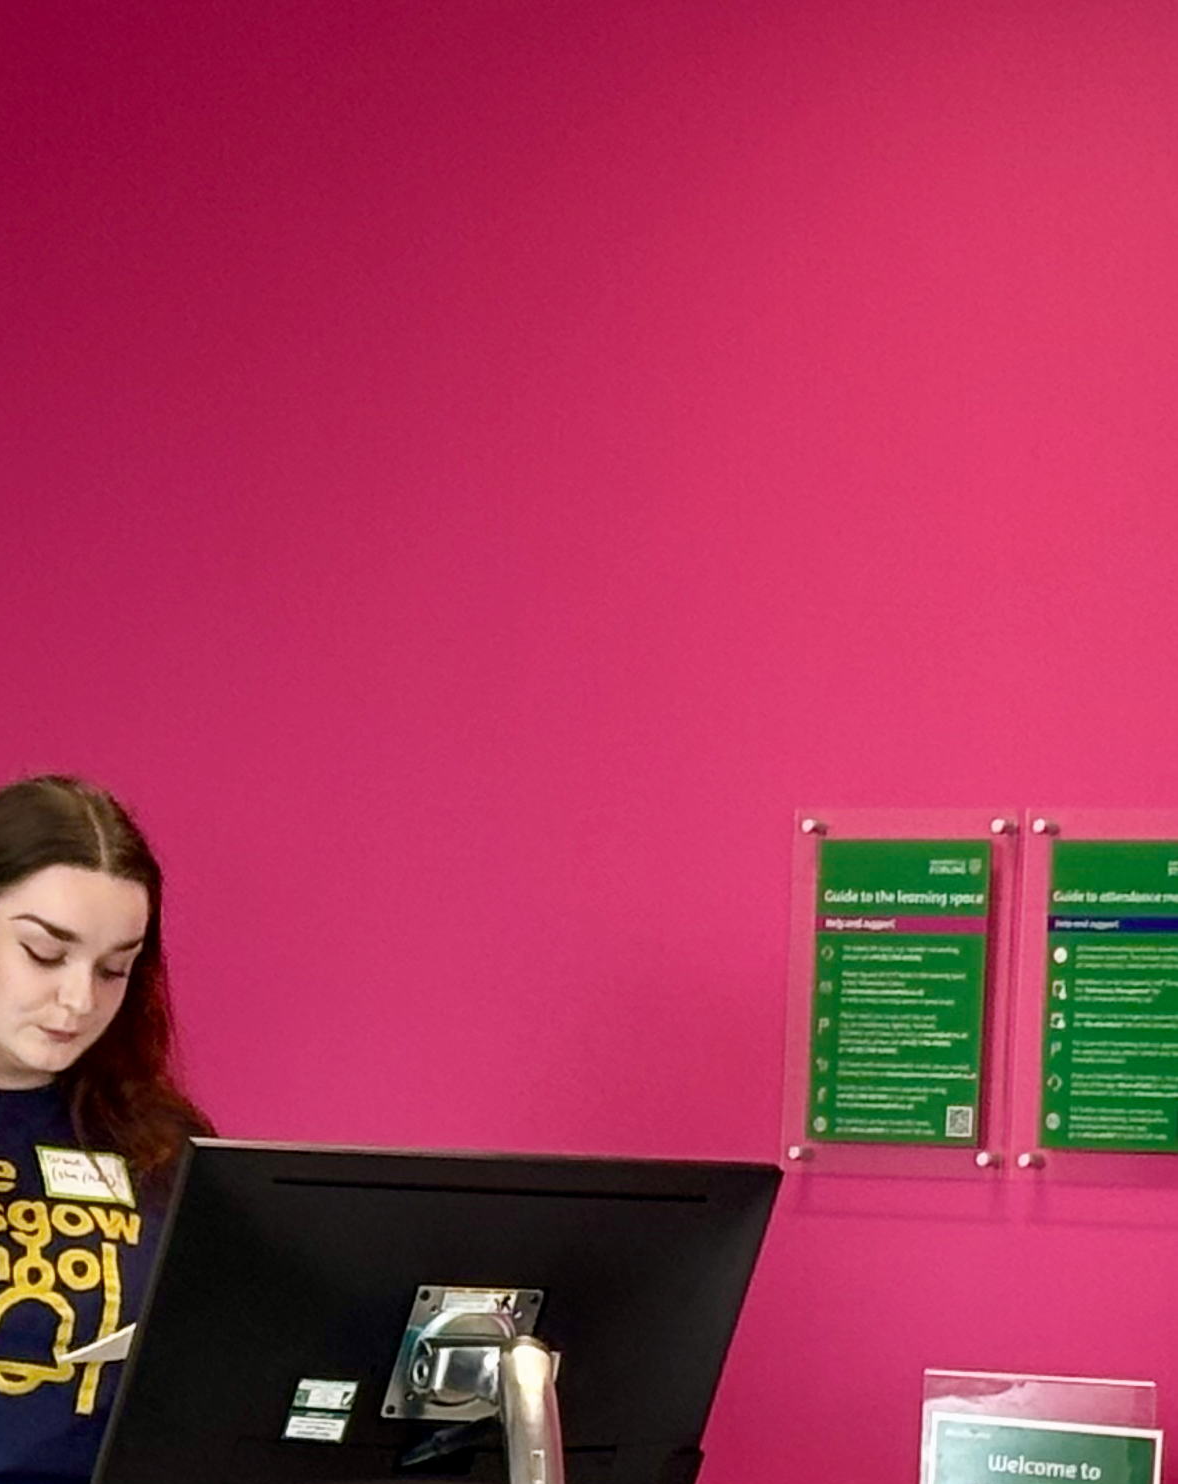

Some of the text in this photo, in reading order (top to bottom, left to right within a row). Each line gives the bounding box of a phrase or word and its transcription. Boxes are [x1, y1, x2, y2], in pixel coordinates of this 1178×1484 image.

[824, 889, 984, 908] Guide to the learning space
[1053, 889, 1084, 902] Guide
[1086, 890, 1098, 902] to
[988, 1453, 1102, 1480] Welcome to
